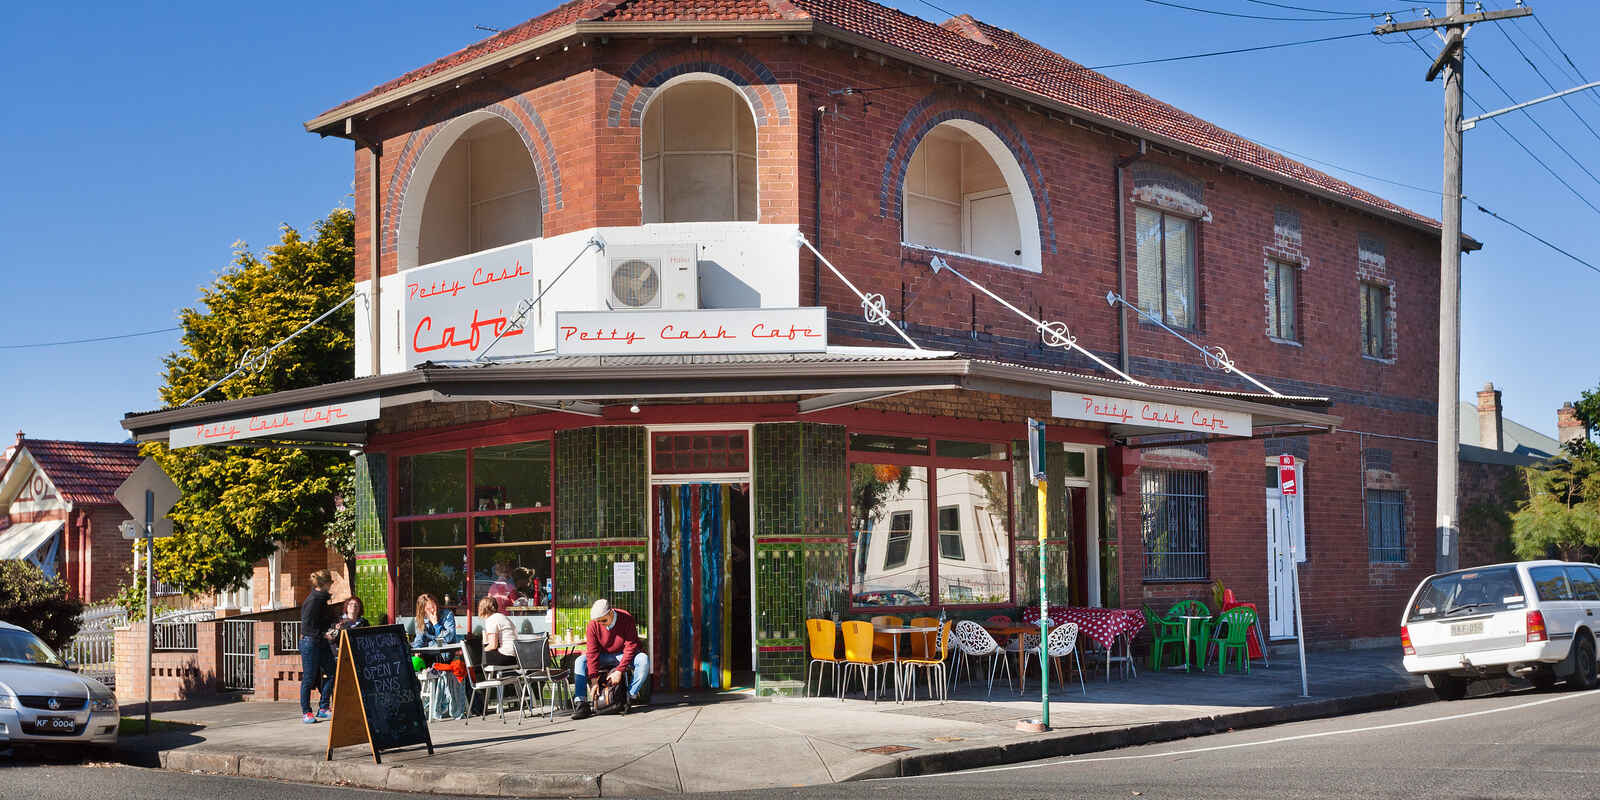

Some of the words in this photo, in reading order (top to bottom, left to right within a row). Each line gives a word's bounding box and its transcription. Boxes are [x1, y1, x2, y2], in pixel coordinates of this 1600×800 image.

[408, 279, 467, 300] Petty
[472, 260, 530, 286] Cash
[560, 326, 645, 345] Petty
[660, 325, 736, 340] Cash
[1082, 397, 1134, 422] Petty
[1142, 404, 1184, 425] Cash
[195, 423, 241, 440] Petty
[249, 412, 294, 432] Cash
